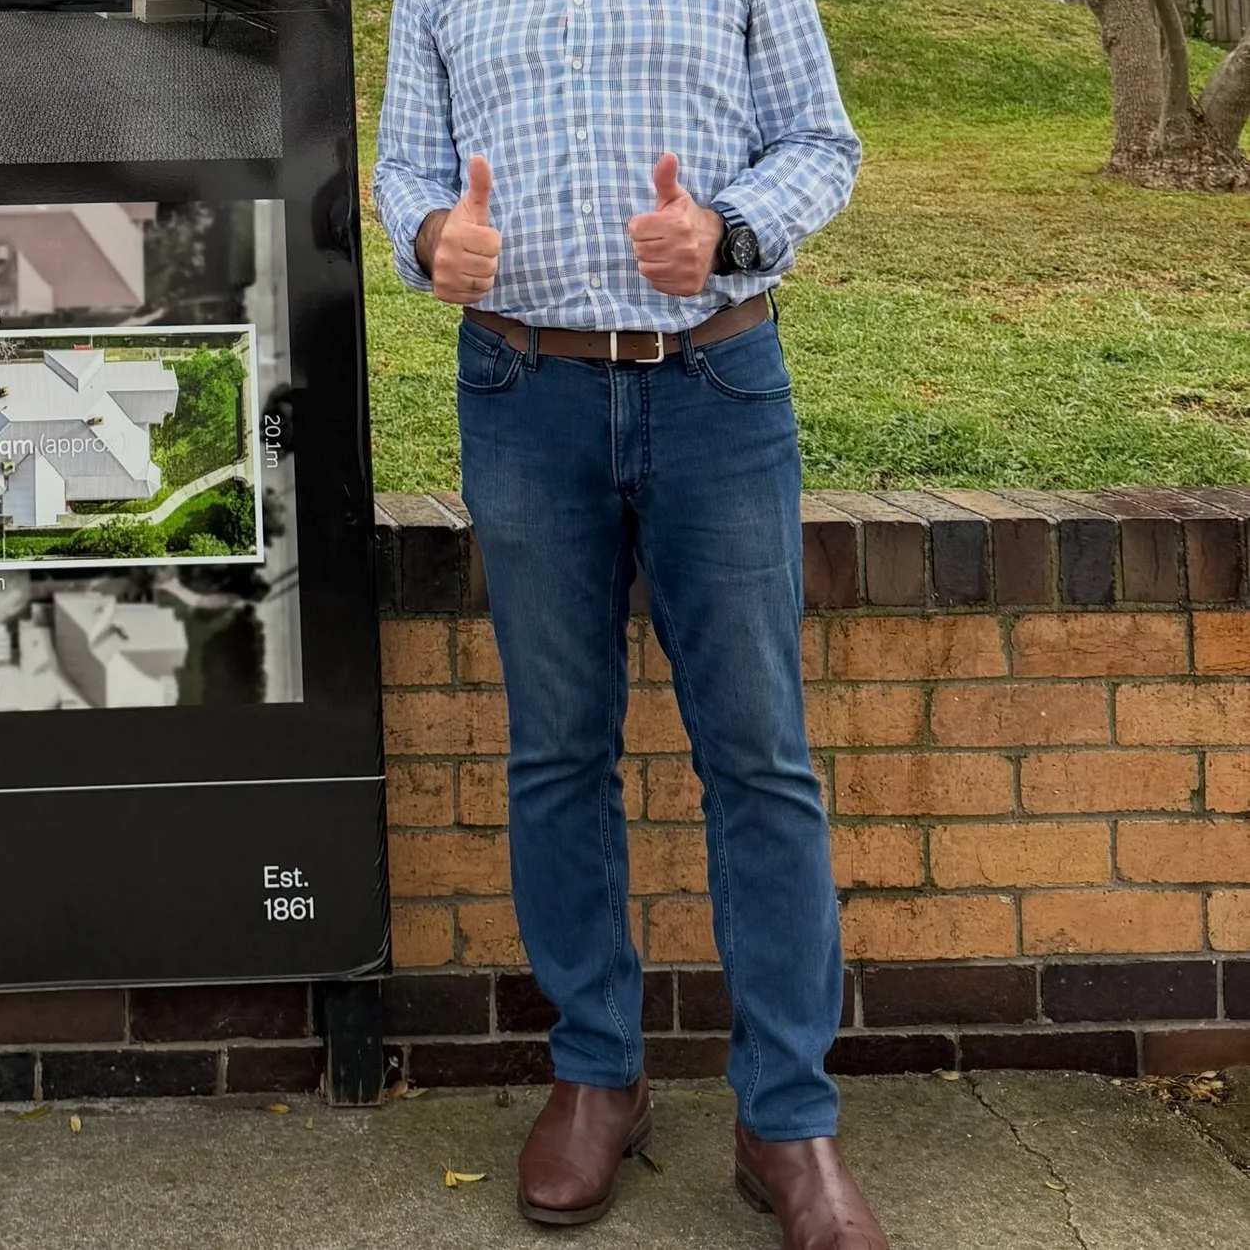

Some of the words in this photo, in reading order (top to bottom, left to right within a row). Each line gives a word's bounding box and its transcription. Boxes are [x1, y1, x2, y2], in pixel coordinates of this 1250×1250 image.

[264, 414, 282, 468] 20.1m
[263, 865, 310, 889] Est.
[262, 893, 315, 922] 1861
